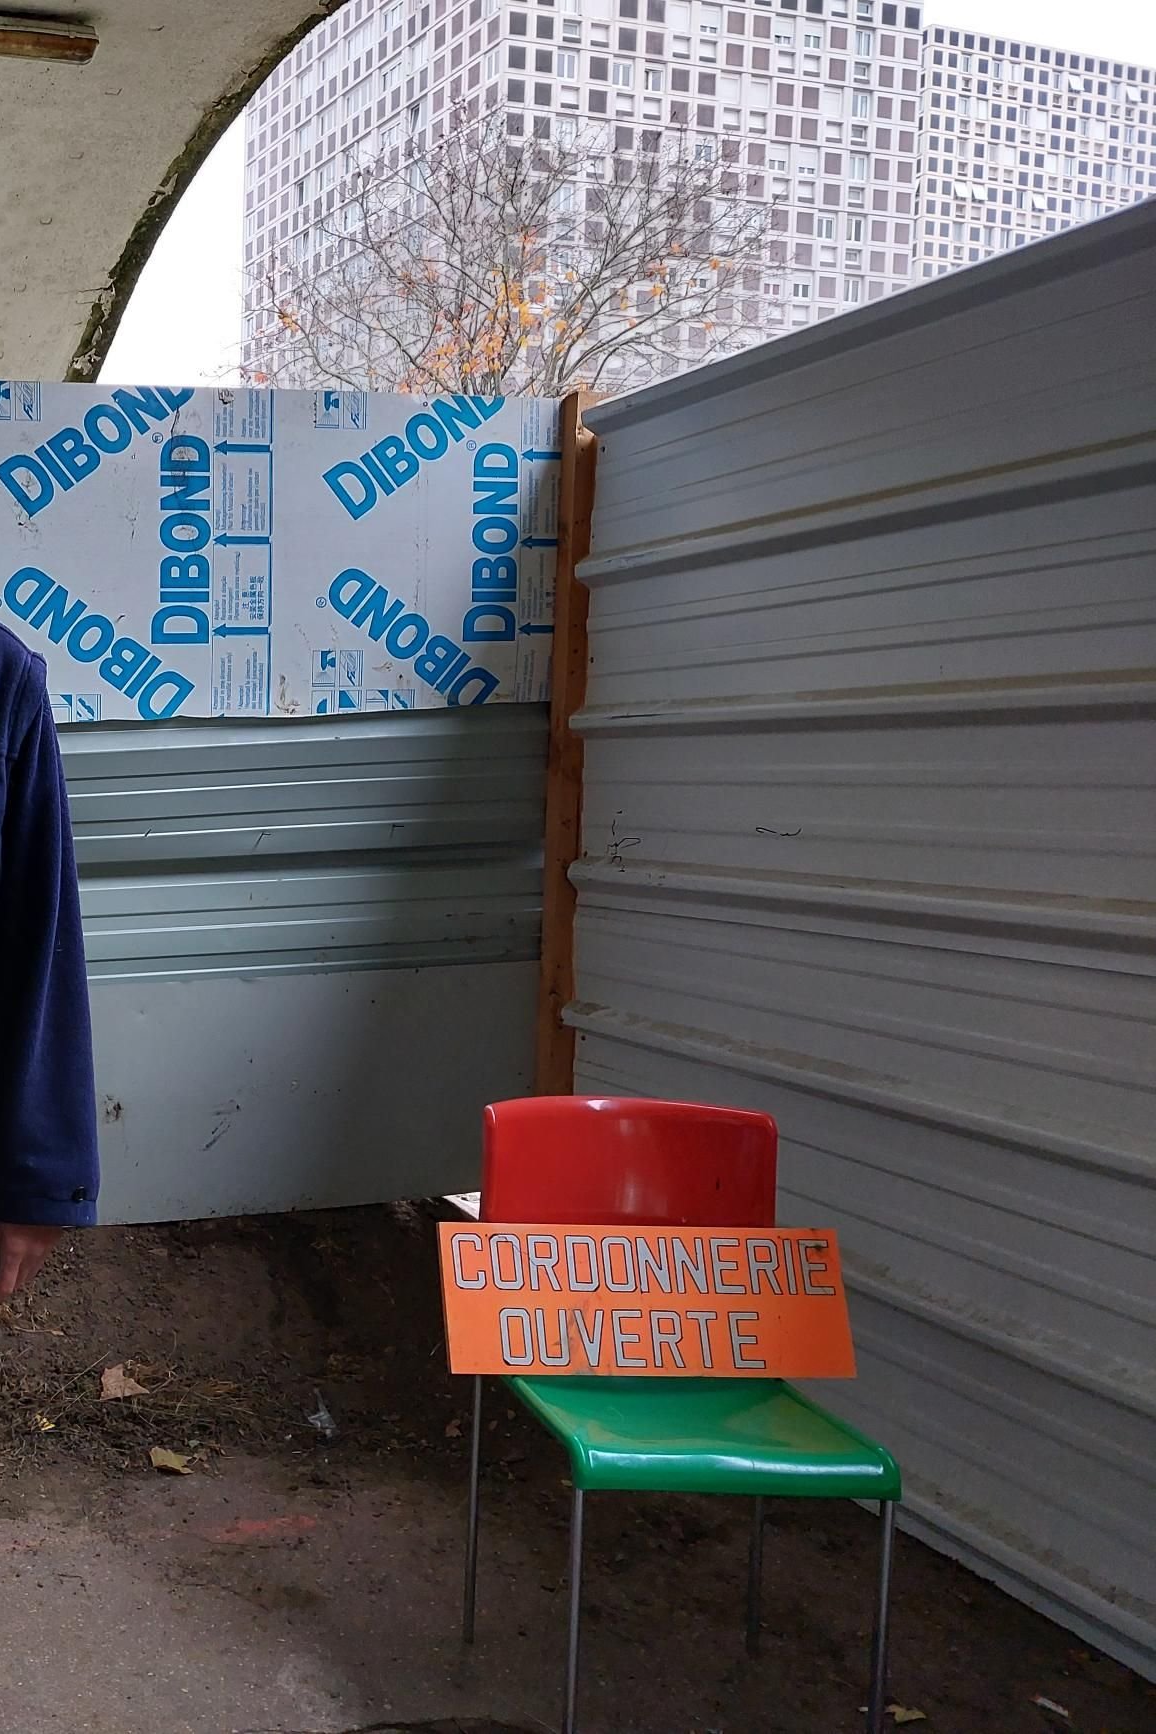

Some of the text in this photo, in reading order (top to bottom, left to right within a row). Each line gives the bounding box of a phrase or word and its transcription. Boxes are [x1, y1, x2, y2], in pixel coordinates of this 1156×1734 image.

[151, 434, 212, 646] DIBOND
[462, 442, 519, 642] DIBOND
[4, 566, 196, 720] DIBOND
[328, 568, 500, 707] DIBOND
[451, 1232, 837, 1296] CORDONNERIE
[499, 1308, 767, 1370] OUVERTE
